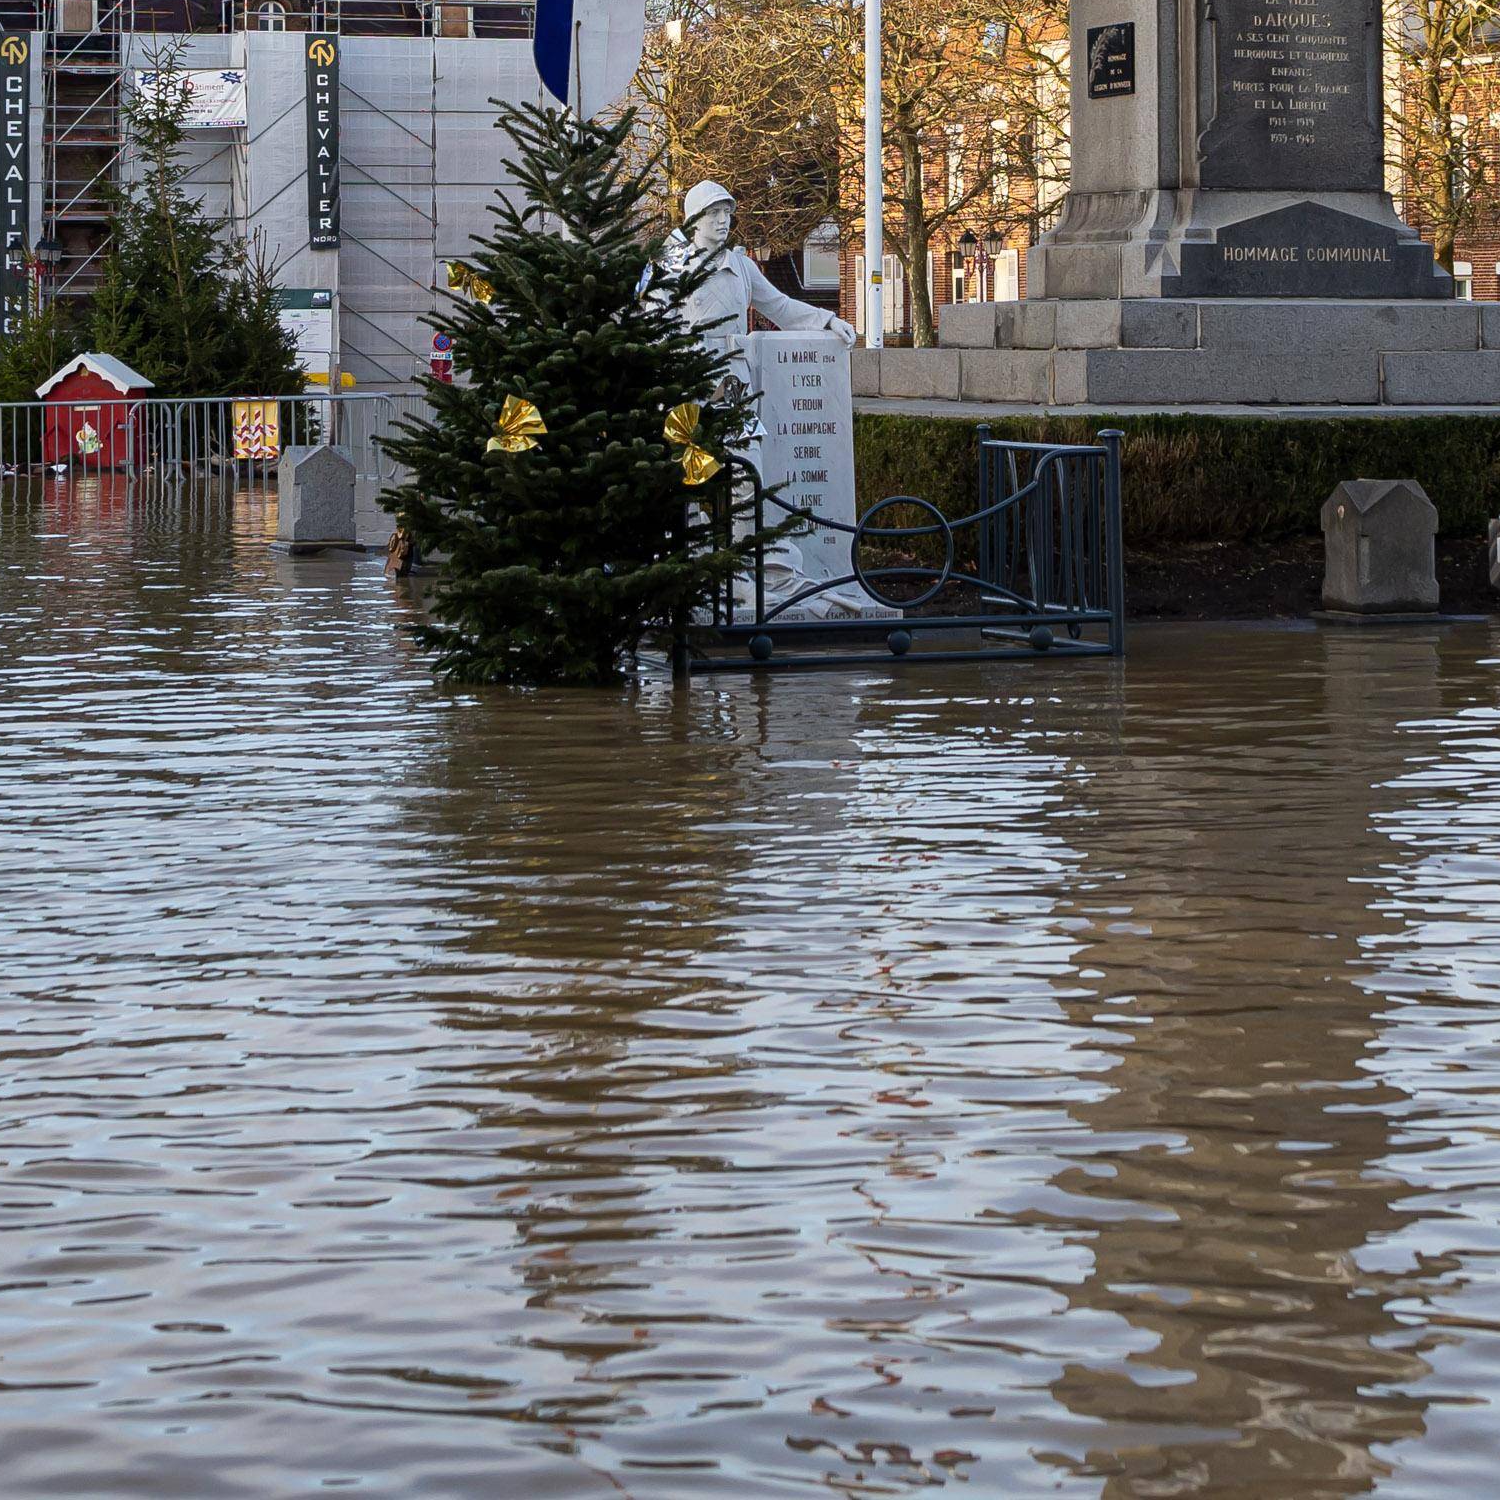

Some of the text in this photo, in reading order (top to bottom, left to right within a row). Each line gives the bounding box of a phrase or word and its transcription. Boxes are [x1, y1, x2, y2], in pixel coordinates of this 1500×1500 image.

[1247, 33, 1263, 43] SES
[1267, 33, 1290, 43] CENT
[1296, 35, 1348, 45] CINQUANTE
[1290, 51, 1302, 60] ET
[1305, 51, 1350, 62] GLORIEUX
[1271, 67, 1312, 77] ENFANTS
[1269, 83, 1294, 94] POUR
[1298, 84, 1310, 93] LA
[1254, 100, 1266, 109] ET
[1271, 100, 1284, 110] LA
[316, 74, 333, 230] CHEVALIER
[313, 235, 337, 243] NORD
[1224, 247, 1391, 262] HOMMAGE COMMUNAL
[778, 351, 788, 363] LA
[792, 351, 818, 363] MARNE
[792, 399, 823, 411] VERDUN
[778, 422, 837, 435] LA CHAMPAGNE
[794, 446, 822, 459] SERBIE
[787, 470, 828, 483] LA SOMME
